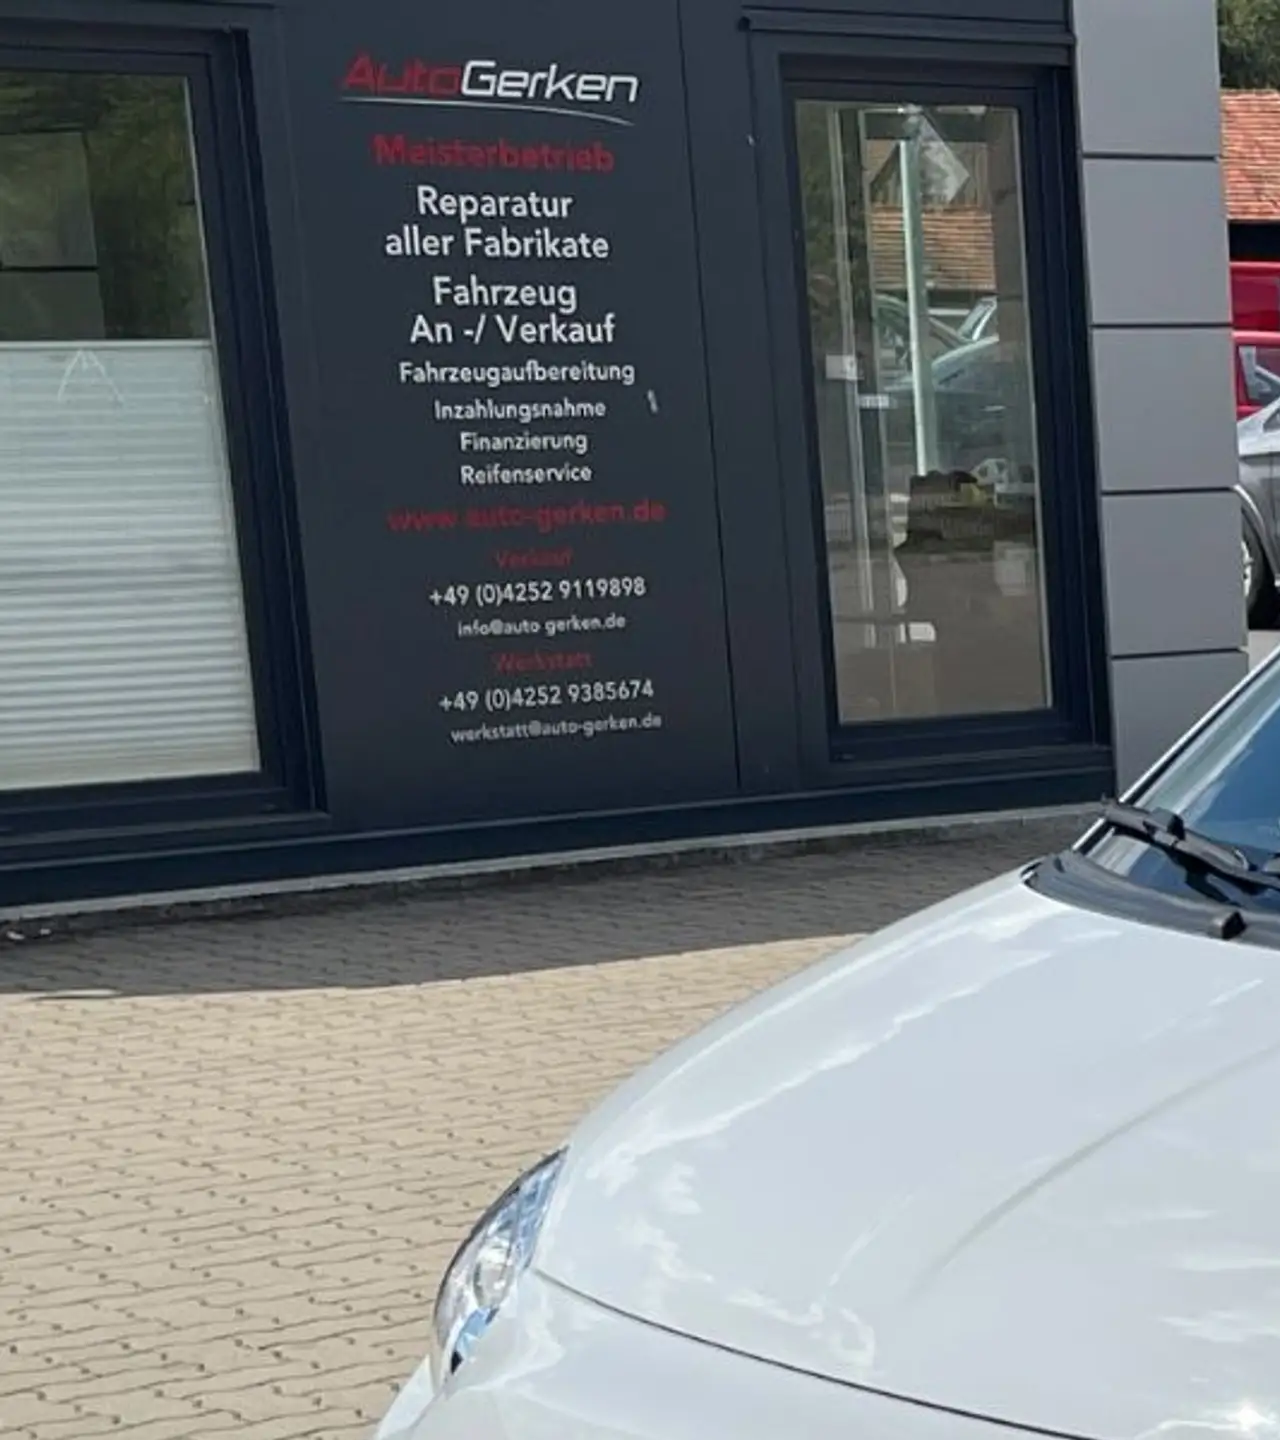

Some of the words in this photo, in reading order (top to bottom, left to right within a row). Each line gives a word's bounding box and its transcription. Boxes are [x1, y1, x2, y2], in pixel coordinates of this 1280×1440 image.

[341, 54, 639, 103] AutoGerken
[373, 135, 615, 172] Meisterbetrieb
[417, 186, 573, 223] Reparatur
[385, 226, 454, 257] aller
[464, 228, 610, 259] Fabrikate
[433, 276, 577, 313] Fahrzeug
[410, 316, 453, 345] An
[495, 313, 616, 344] Verkauf
[400, 360, 636, 387] Fahrzeugaufbereitung
[435, 399, 606, 423] Inzahlungsnahme
[460, 431, 588, 454] Finanzierung
[461, 464, 592, 485] Reifenservice
[388, 500, 668, 532] wwwauto-gerken.de
[430, 585, 469, 606] +49
[476, 580, 553, 607] (0)4252
[560, 577, 647, 600] 9119898
[458, 612, 626, 638] info@autogerken.de
[439, 689, 479, 712] +49
[485, 686, 562, 711] (0)4252
[568, 679, 654, 703] 9385674
[451, 711, 662, 743] werkstatt@auto-gerken.de
